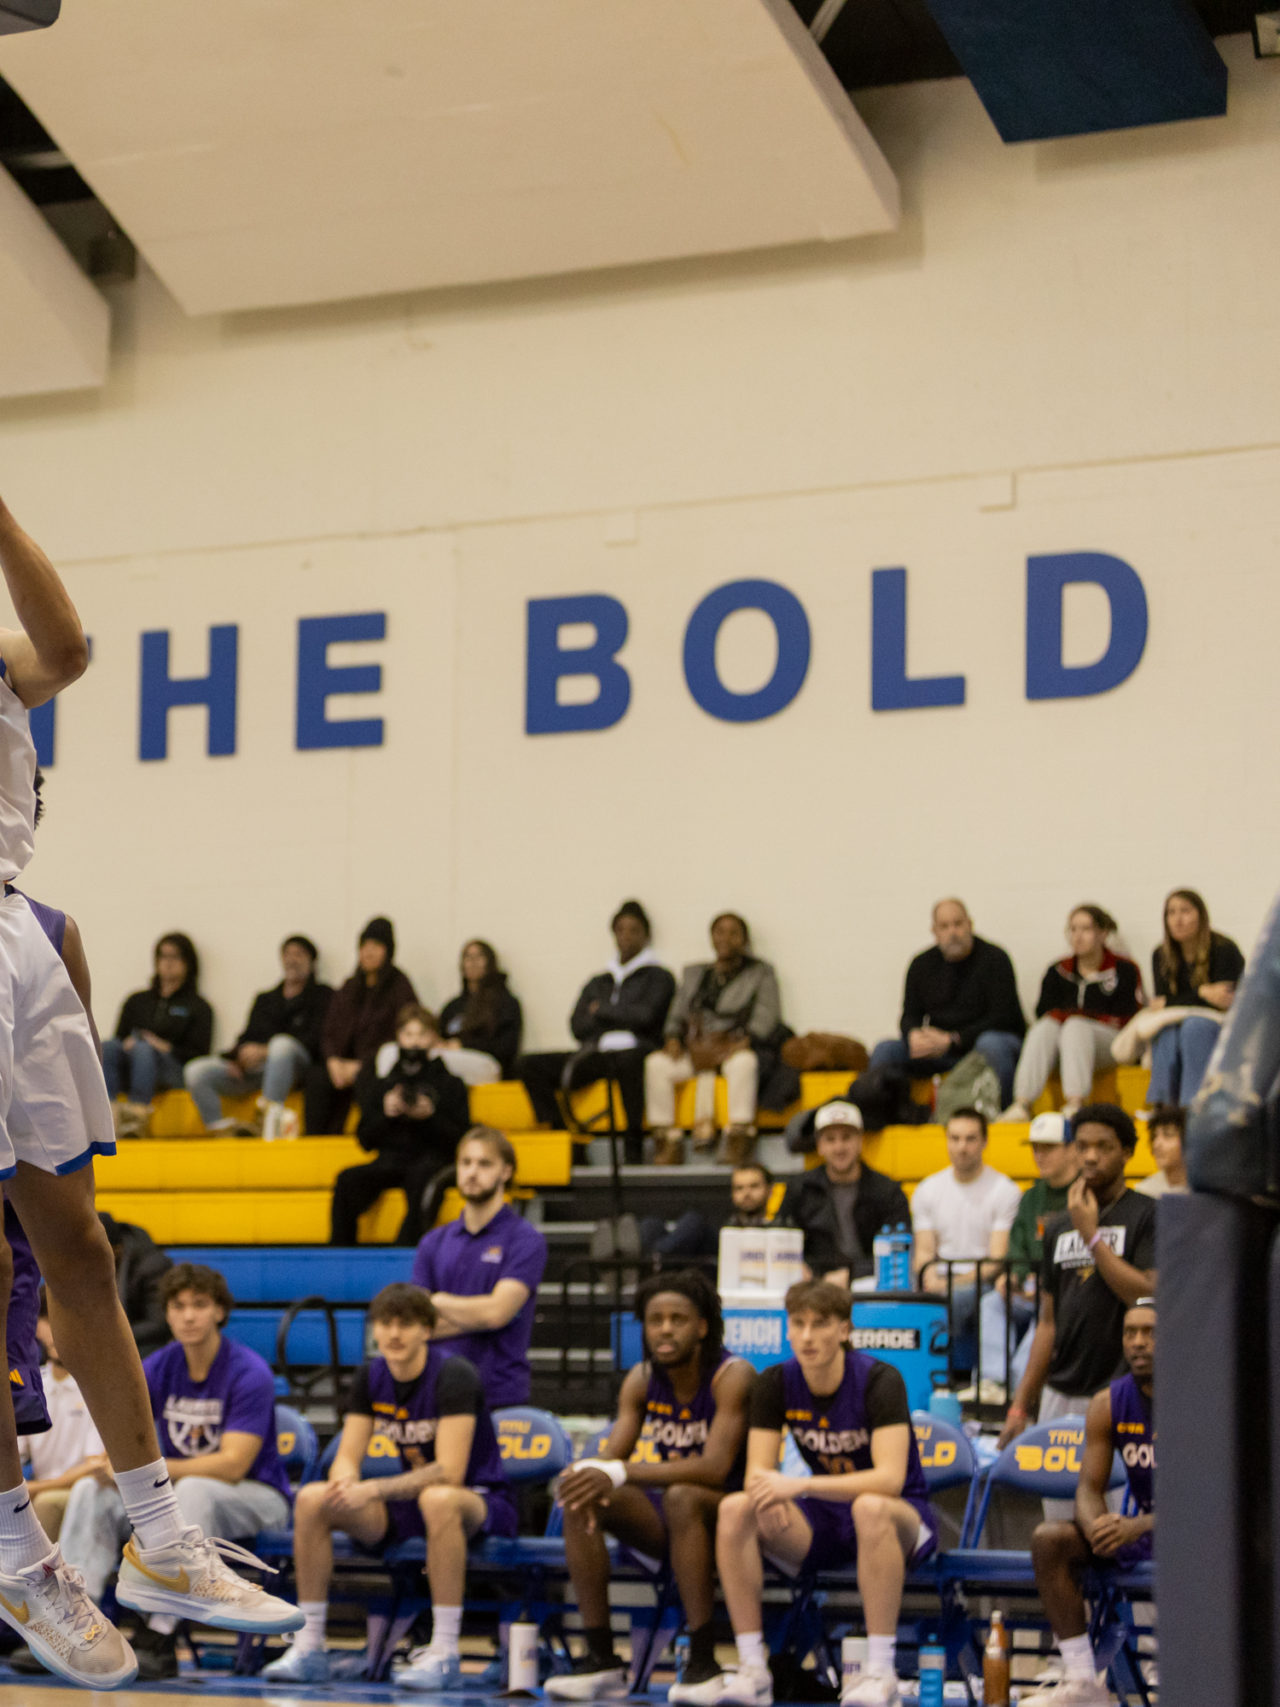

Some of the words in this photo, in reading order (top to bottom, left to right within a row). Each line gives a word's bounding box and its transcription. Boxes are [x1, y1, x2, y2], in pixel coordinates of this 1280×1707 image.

[30, 611, 387, 768] HE
[524, 550, 1150, 737] BOLD
[850, 1328, 915, 1349] ERADE
[497, 1434, 552, 1460] OLD
[919, 1441, 957, 1468] LD
[1014, 1445, 1083, 1472] BOL
